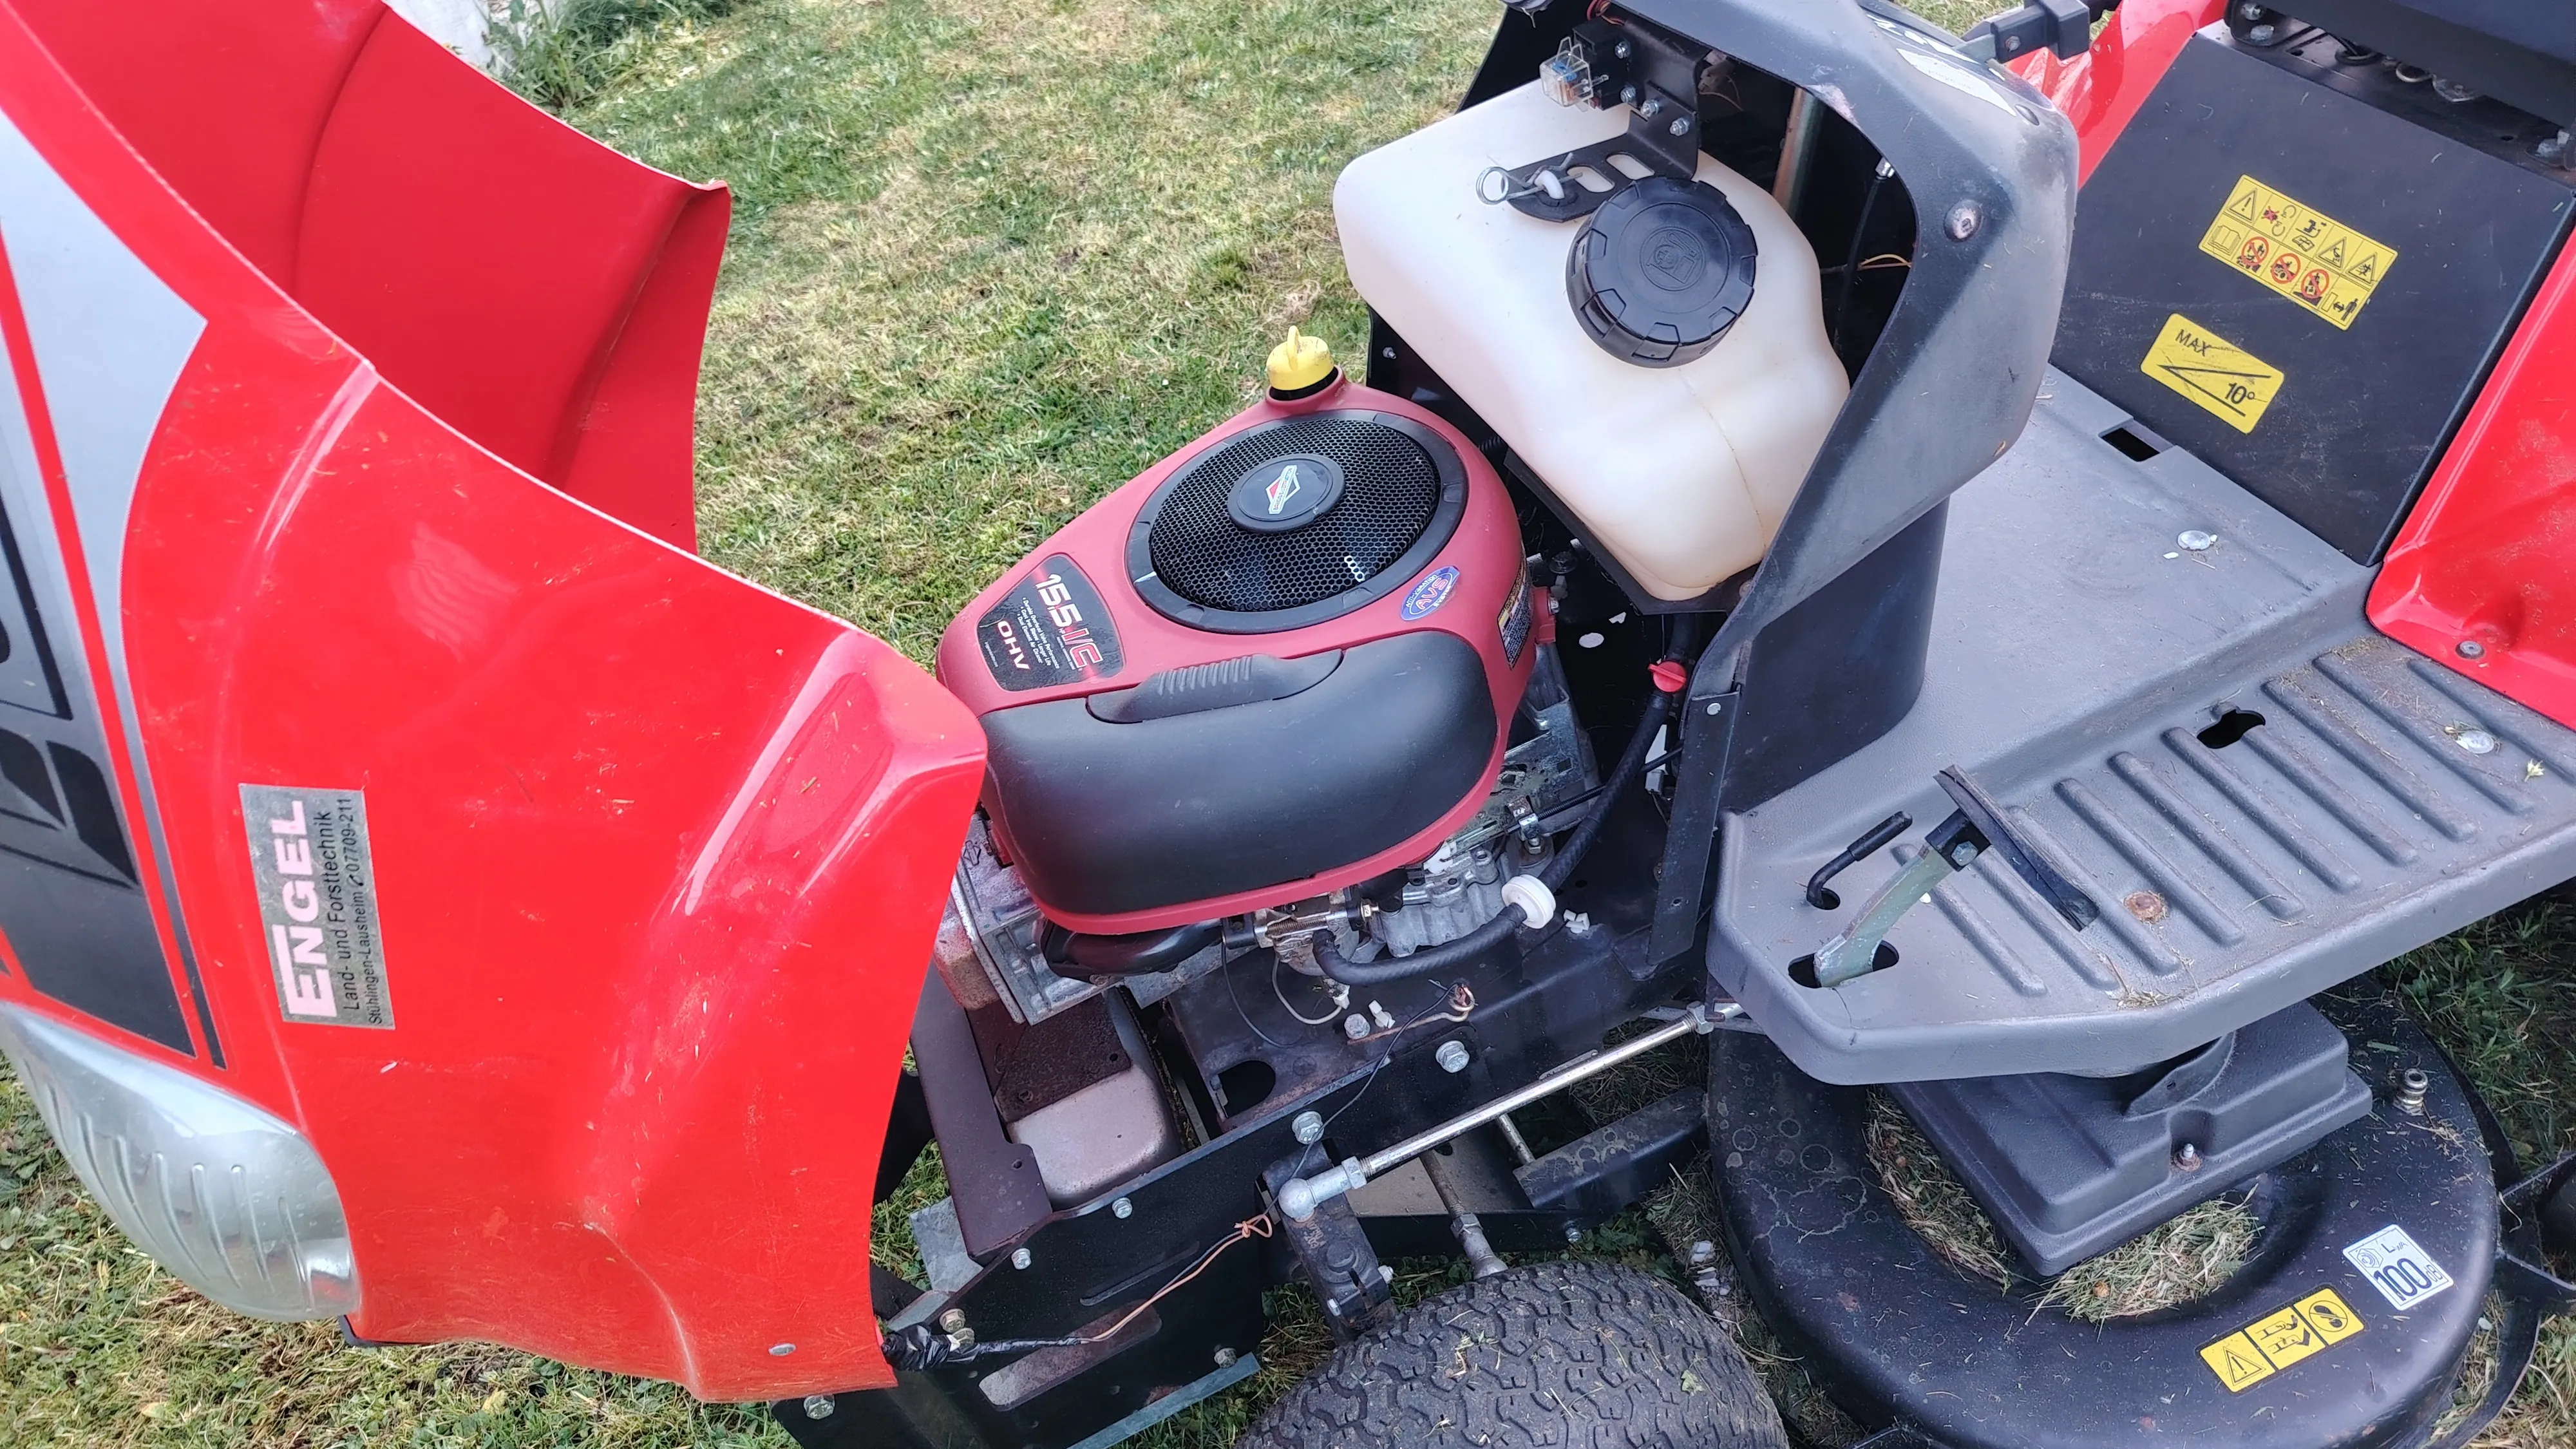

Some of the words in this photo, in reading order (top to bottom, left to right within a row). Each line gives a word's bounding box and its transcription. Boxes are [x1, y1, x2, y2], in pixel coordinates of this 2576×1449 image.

[2175, 328, 2211, 357] MAX
[1414, 577, 1448, 611] AVS
[998, 620, 1031, 670] OHV
[337, 797, 361, 871] 07709-211
[313, 811, 345, 925] Forsttechnik
[271, 800, 337, 1018] ENGEL
[335, 926, 349, 961] und
[343, 965, 360, 1010] Land-
[2373, 1257, 2432, 1302] 100
